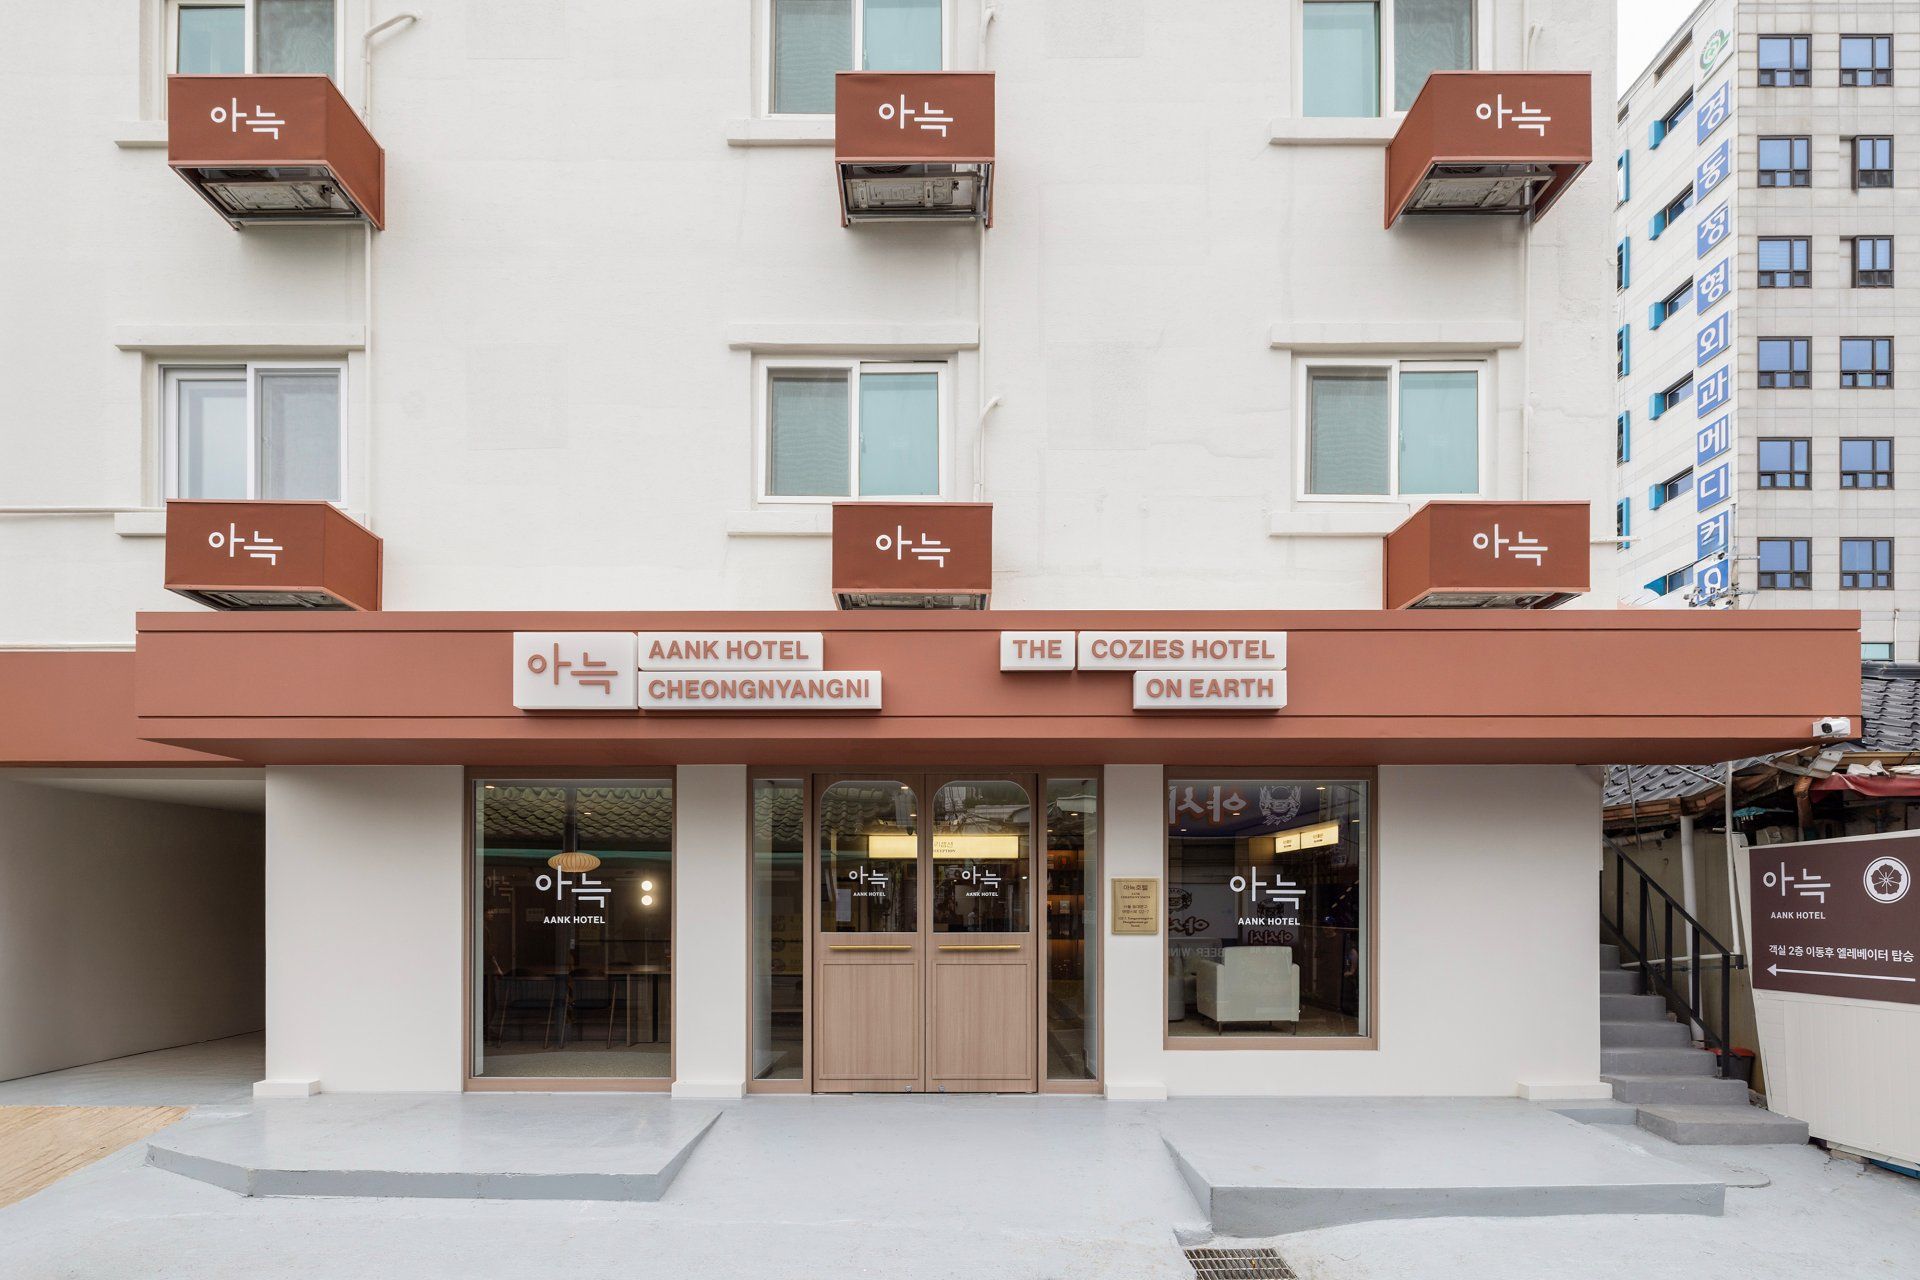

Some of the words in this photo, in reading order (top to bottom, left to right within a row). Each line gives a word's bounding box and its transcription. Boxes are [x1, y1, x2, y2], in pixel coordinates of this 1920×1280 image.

[210, 97, 285, 140] 아늑
[879, 94, 954, 138] 아늑
[1476, 93, 1551, 137] 아늑
[208, 522, 283, 566] 아늑
[875, 525, 950, 568] 아늑
[1473, 523, 1548, 566] 아늑
[648, 639, 719, 661] AANK
[726, 639, 808, 661] HOTEL
[1011, 639, 1063, 660] THE
[1090, 639, 1185, 660] COZIES
[1191, 639, 1275, 660] HOTEL
[528, 641, 619, 695] 아늑
[648, 678, 870, 700] CHEONGNYANGNI
[1146, 677, 1183, 699] ON
[1189, 677, 1274, 699] EARTH
[535, 865, 612, 908] 아늑
[848, 866, 889, 889] 아늑
[962, 866, 1001, 889] 아늑
[1229, 866, 1306, 910] 아늑
[1763, 862, 1831, 904] 아늑
[543, 915, 571, 924] AANK
[573, 915, 606, 924] HOTEL
[1237, 917, 1265, 926] AANK
[1267, 917, 1301, 926] HOTEL
[1770, 911, 1795, 920] AANK
[1796, 911, 1826, 920] HOTEL
[1769, 944, 1786, 956] 객실
[1788, 945, 1804, 957] 2층
[1806, 946, 1835, 958] 이동후
[1891, 949, 1915, 963] 탑승
